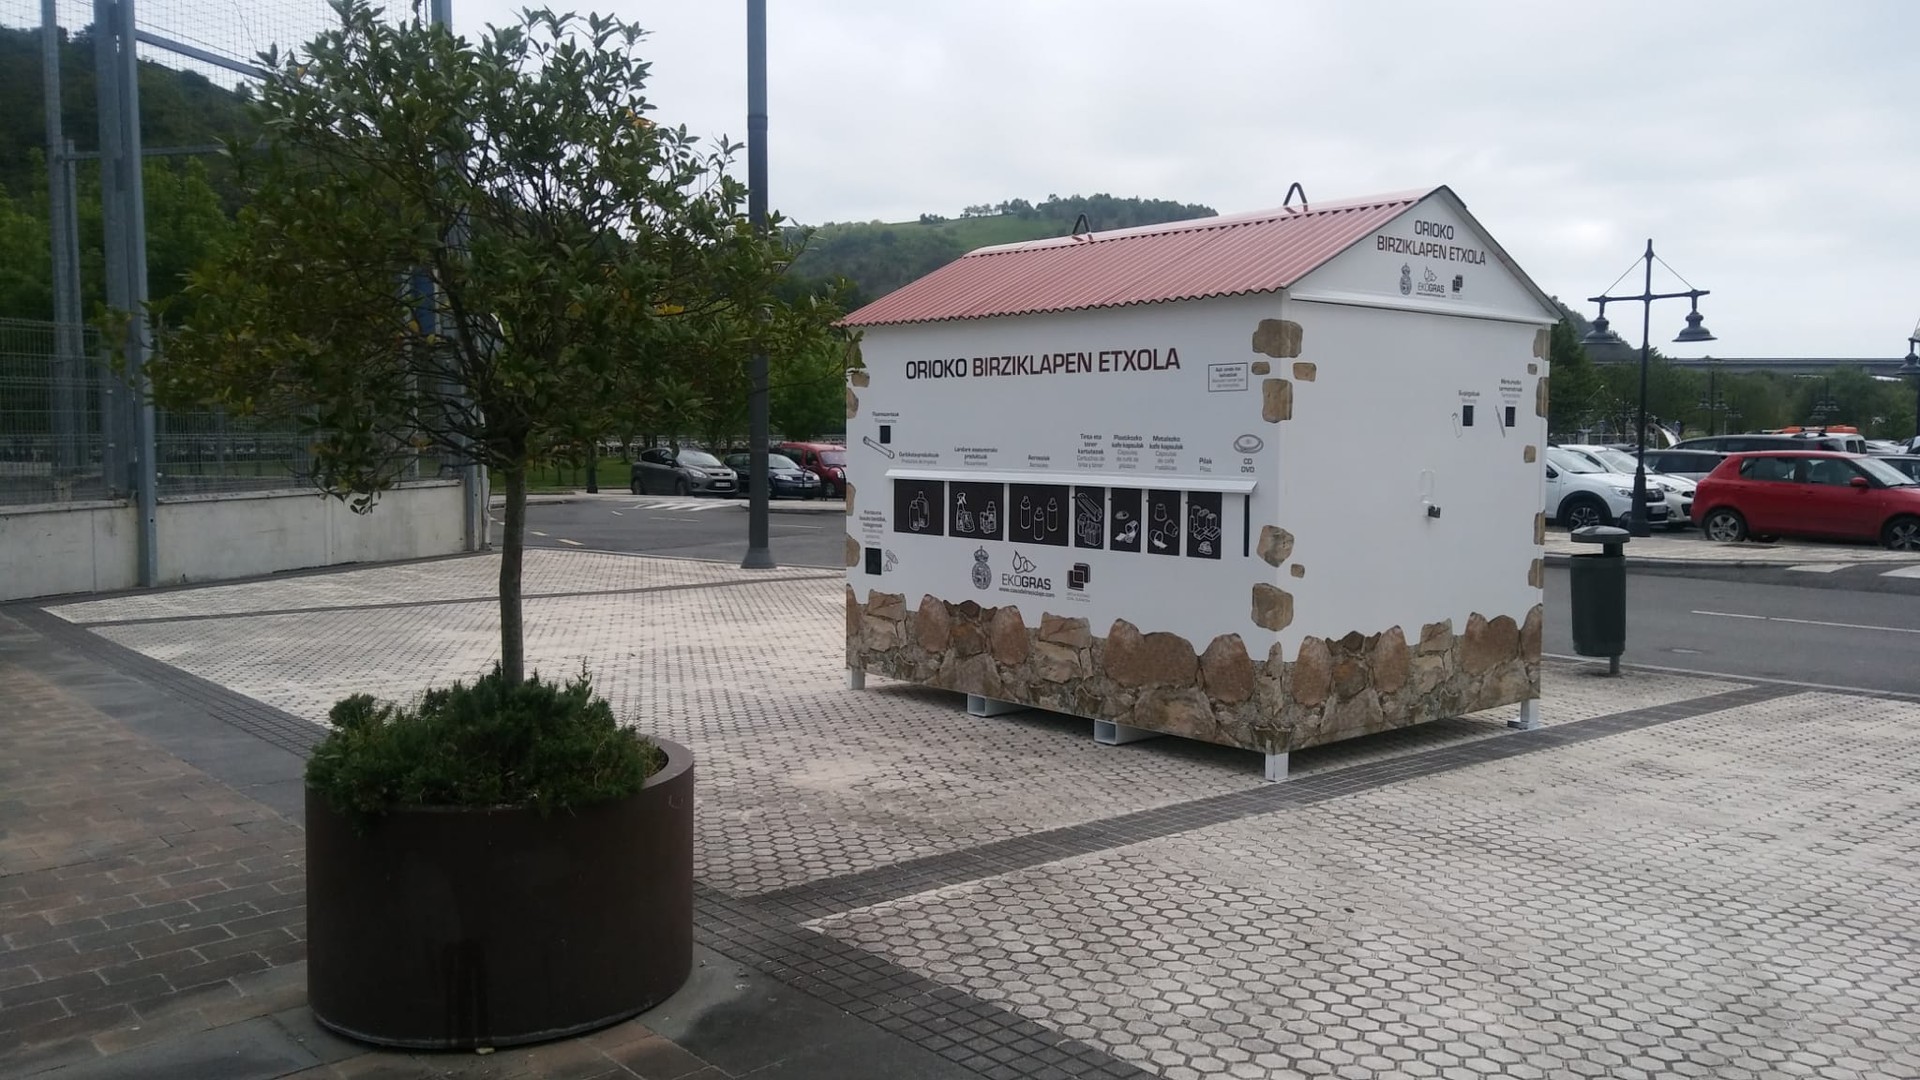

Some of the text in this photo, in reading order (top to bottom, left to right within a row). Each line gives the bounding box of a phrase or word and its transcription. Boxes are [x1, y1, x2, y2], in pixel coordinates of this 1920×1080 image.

[1415, 220, 1454, 240] ORIOKO
[1377, 235, 1486, 266] BIRZIKLAPEN ETXOLA
[906, 347, 1181, 379] ORIOKO BIRZIKLAPEN ETXOLA
[1002, 573, 1051, 590] EKOGRAS
